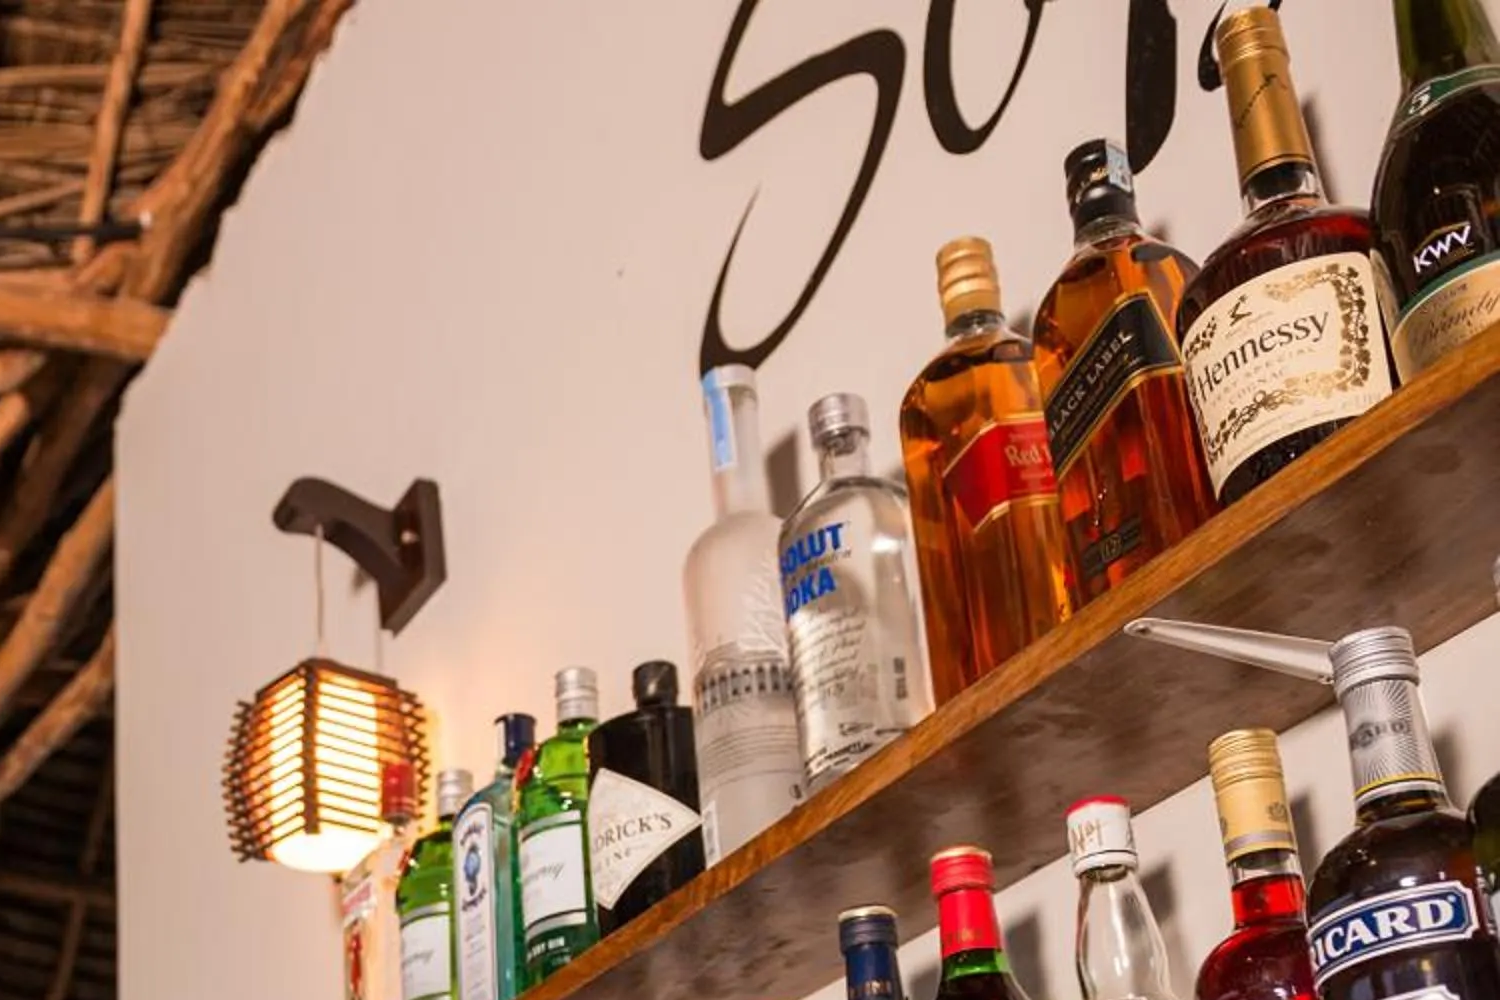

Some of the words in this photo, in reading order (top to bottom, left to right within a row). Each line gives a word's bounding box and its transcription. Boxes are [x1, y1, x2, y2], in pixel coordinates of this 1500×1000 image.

[1412, 224, 1471, 273] KWV
[1086, 330, 1135, 385] LABEL
[1196, 311, 1329, 402] Hennessy
[1314, 898, 1453, 966] ICARD
